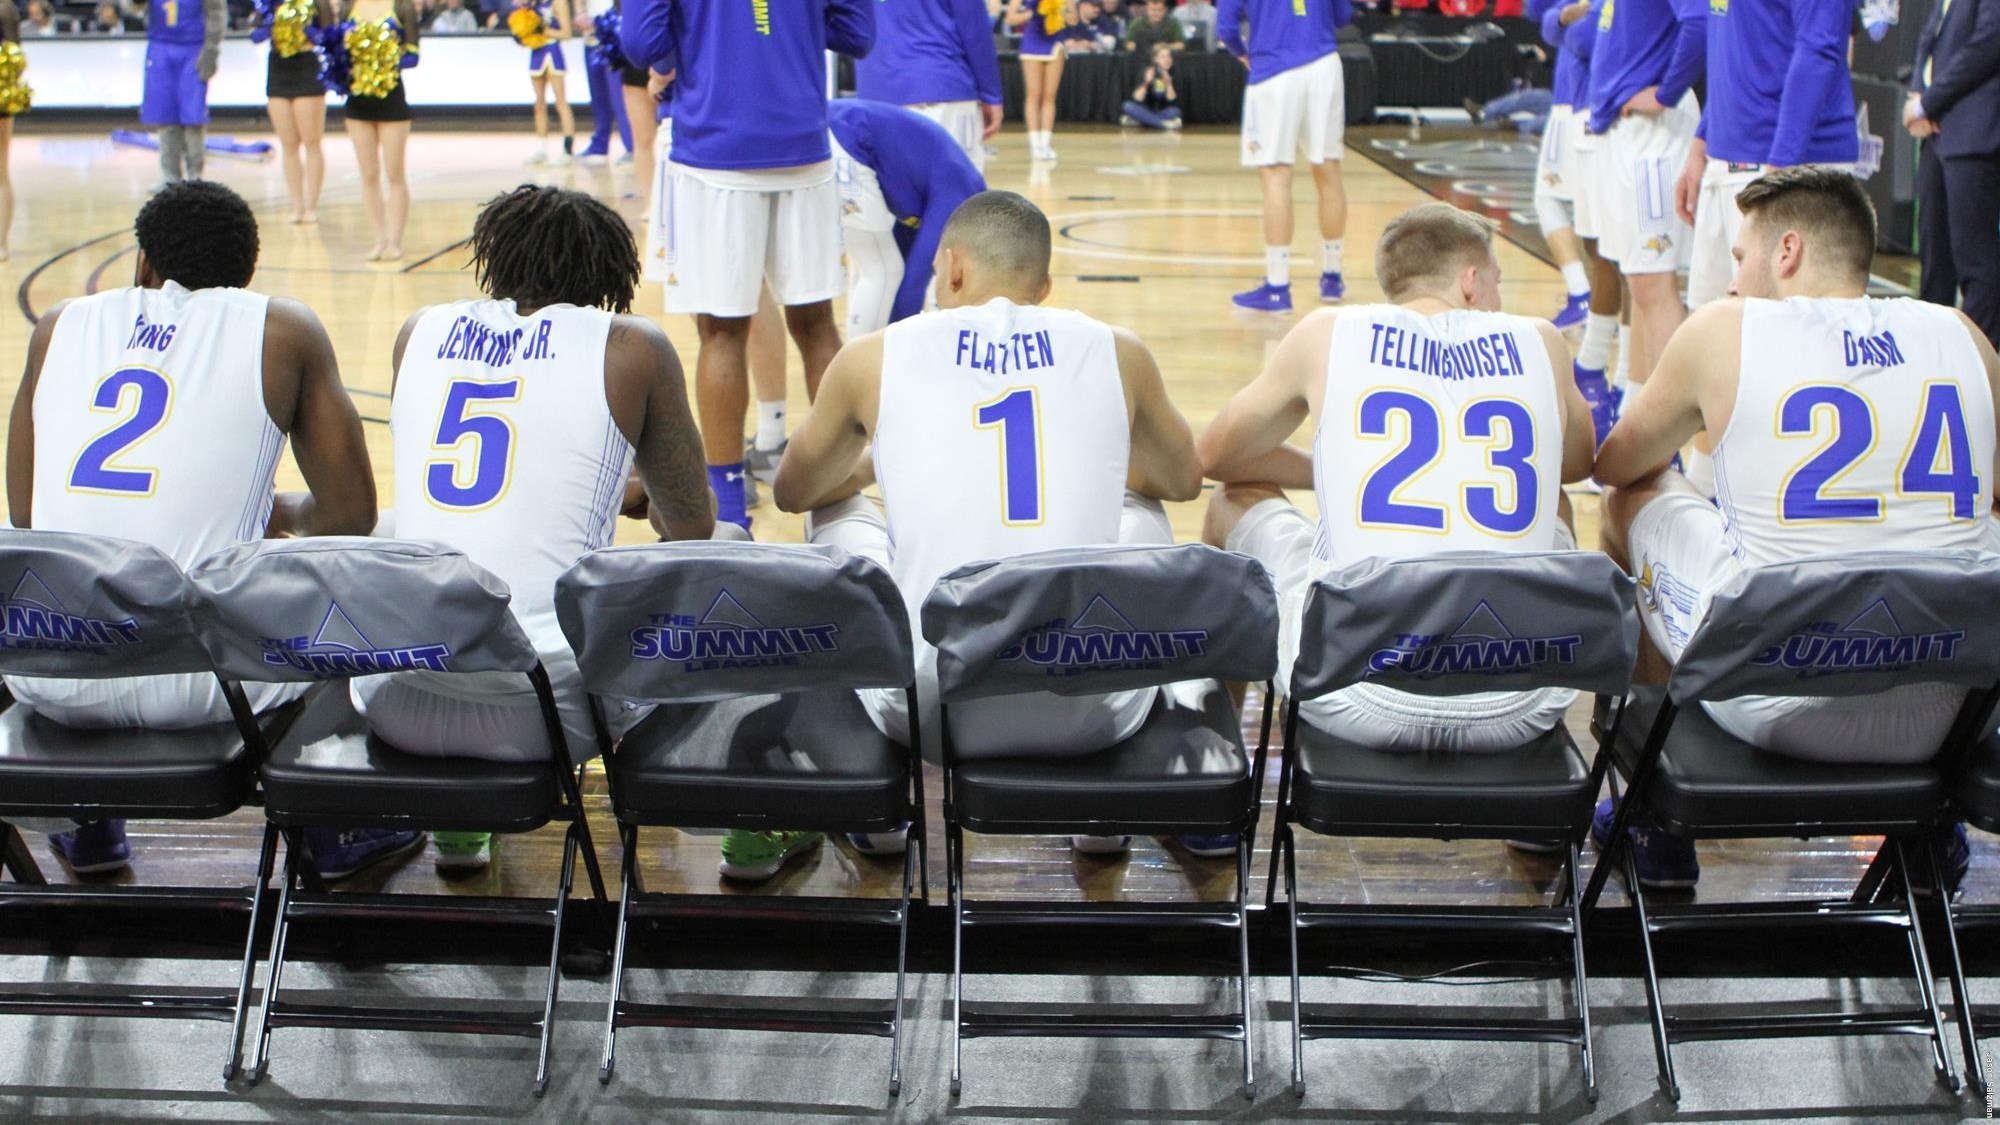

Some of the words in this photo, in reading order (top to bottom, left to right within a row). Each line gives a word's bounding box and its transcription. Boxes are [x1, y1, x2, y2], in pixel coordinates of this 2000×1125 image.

[162, 1, 177, 28] 1
[437, 315, 523, 367] JENKINS
[523, 319, 555, 360] JR.
[956, 329, 1055, 375] FLATTEN
[1370, 323, 1524, 381] TELLINGHUISEN
[1843, 330, 1905, 367] DAUM
[66, 362, 175, 499] 2
[423, 376, 525, 514] 5
[972, 385, 1046, 528] 1
[1774, 379, 1982, 527] 24
[1355, 385, 1541, 540] 23
[0, 604, 144, 645] MMIT
[629, 602, 842, 662] SUMMIT
[649, 613, 696, 628] THE
